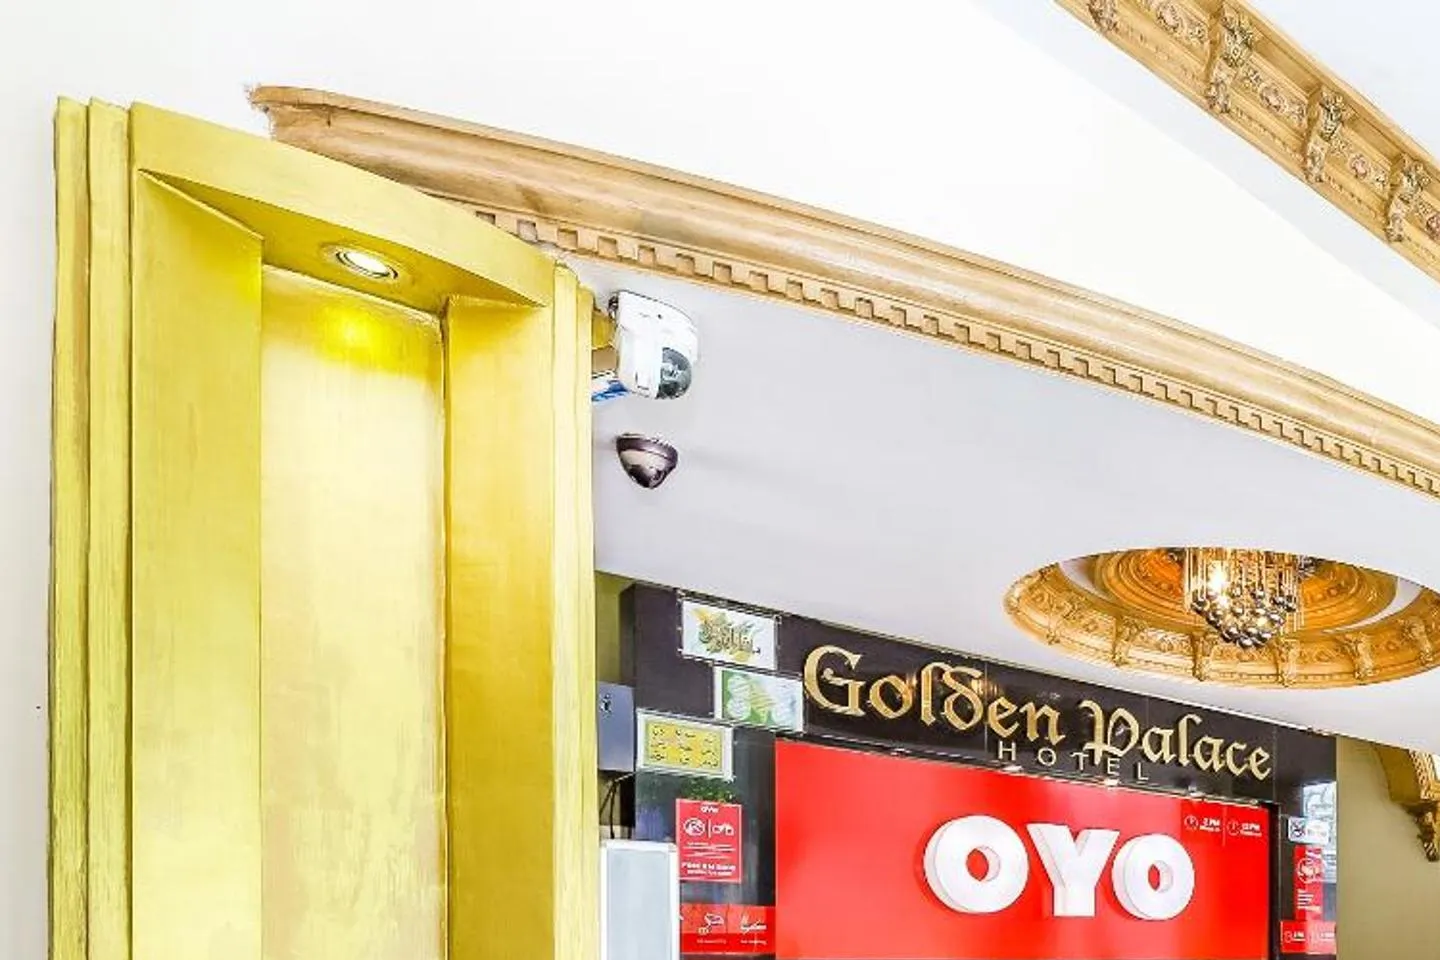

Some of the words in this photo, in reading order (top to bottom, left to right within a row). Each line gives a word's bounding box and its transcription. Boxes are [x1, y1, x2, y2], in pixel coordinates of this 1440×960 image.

[803, 644, 1066, 745] Golden
[1080, 699, 1271, 781] Palace
[998, 740, 1150, 781] HOTEL
[923, 814, 1196, 921] OYO
